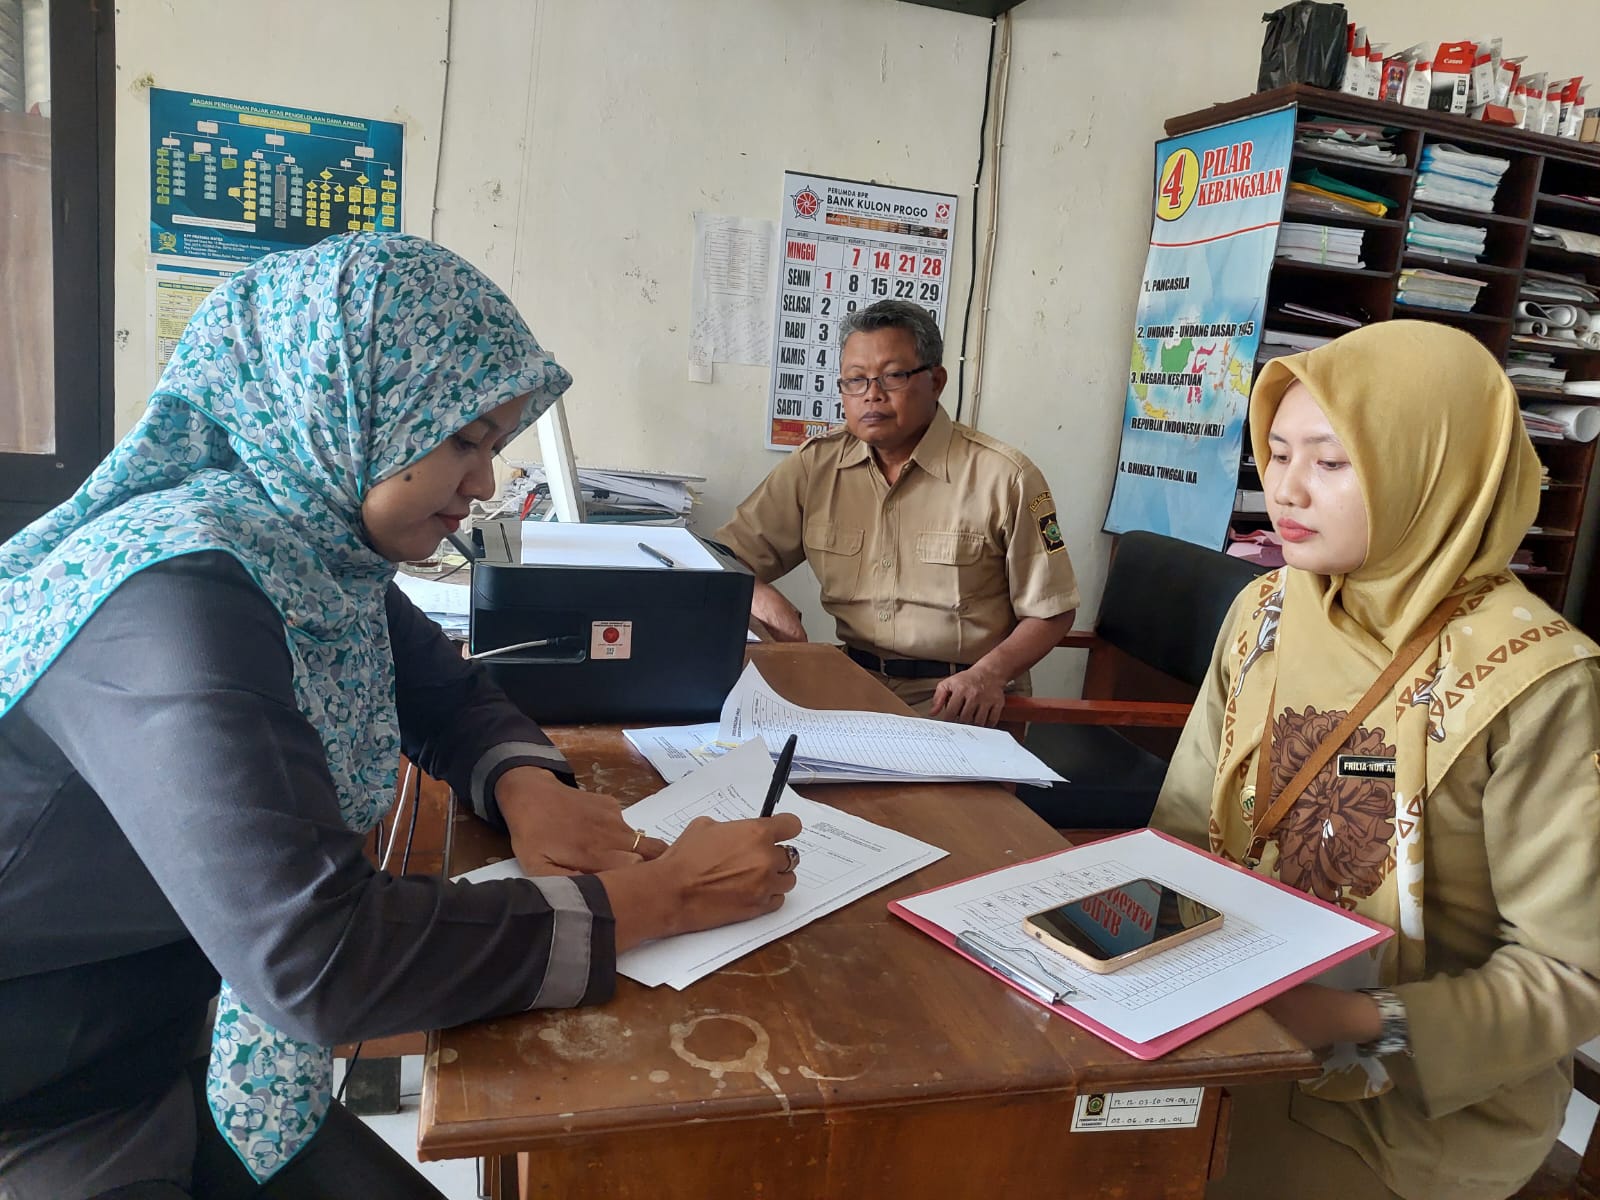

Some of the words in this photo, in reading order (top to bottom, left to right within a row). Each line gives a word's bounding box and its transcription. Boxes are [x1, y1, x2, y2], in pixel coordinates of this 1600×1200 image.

[1201, 141, 1253, 179] PILAR
[1162, 152, 1186, 209] 4
[1197, 168, 1284, 207] KEBANGSAAN
[827, 187, 856, 197] PERUMDA
[827, 194, 854, 208] BANK
[857, 198, 891, 213] KULON
[893, 204, 928, 218] PROGO
[787, 240, 816, 261] MINGGU
[852, 247, 861, 266] 7
[873, 251, 890, 270] 14
[898, 254, 916, 273] 21
[922, 257, 942, 276] 28
[787, 267, 811, 287] SENIN
[824, 271, 832, 289] 1
[848, 274, 859, 292] 8
[870, 277, 888, 296] 15
[894, 279, 914, 299] 22
[920, 282, 939, 301] 29
[1151, 276, 1190, 292] PANCASILA
[783, 294, 811, 314] SELASA
[820, 297, 830, 316] 2
[784, 320, 806, 340] RABU
[818, 323, 829, 341] 3
[1147, 326, 1174, 338] UNDANG
[1180, 325, 1209, 337] UNDANG
[1210, 324, 1237, 337] DASAR
[780, 346, 806, 366] KAMIS
[816, 349, 827, 367] 4
[778, 372, 804, 391] JUMAT
[814, 374, 825, 392] 5
[1140, 372, 1165, 385] NEGARA
[1168, 373, 1202, 387] KESATUAN
[776, 398, 802, 417] SABTU
[812, 400, 823, 418] 6
[1131, 418, 1163, 430] REPUBLIK
[1164, 421, 1200, 436] INDONESIA
[1128, 462, 1155, 477] BHINEKA
[1157, 467, 1184, 482] TUNGGAL
[1185, 471, 1197, 484] IKA
[1344, 761, 1367, 771] FRILIA
